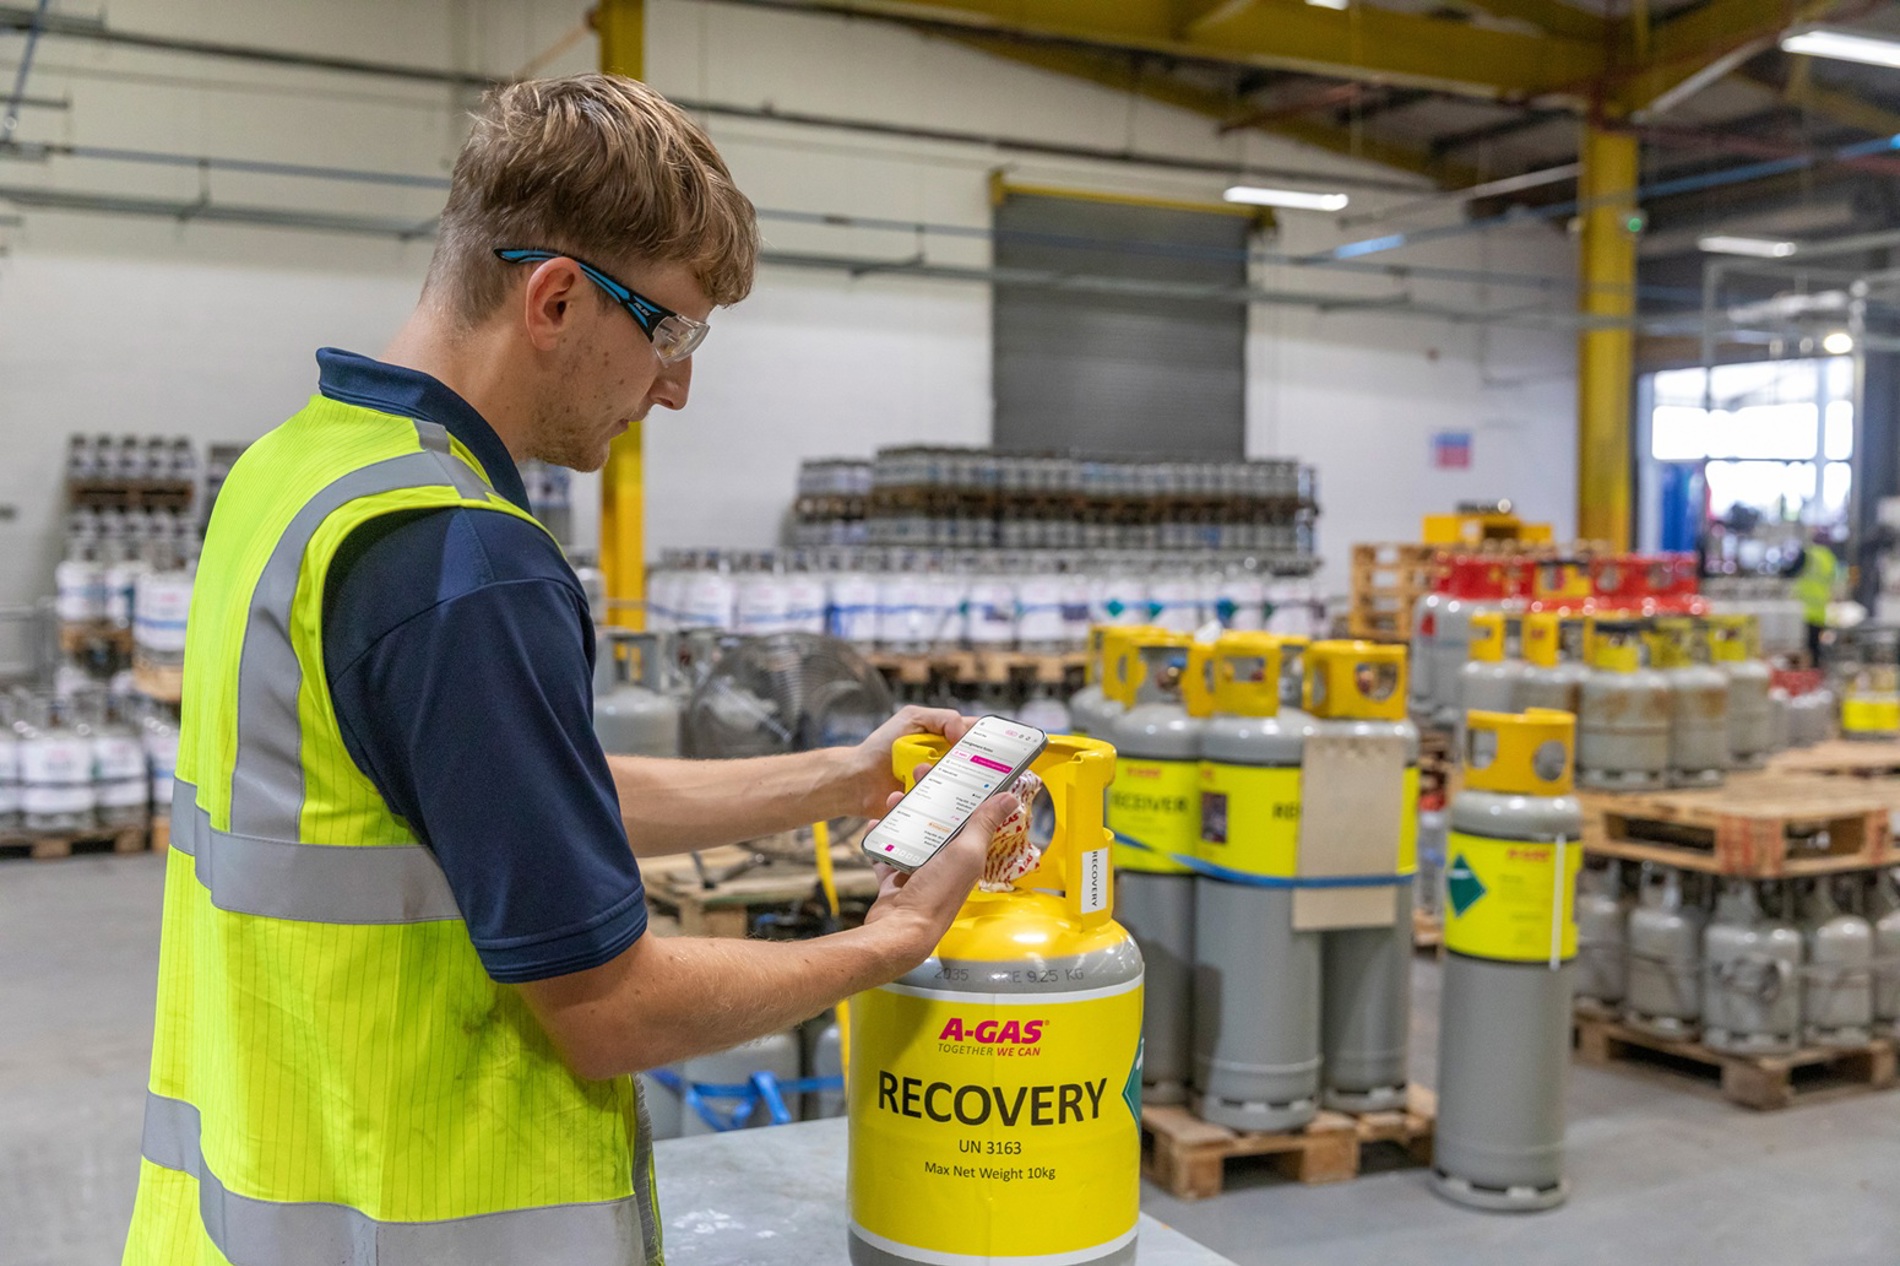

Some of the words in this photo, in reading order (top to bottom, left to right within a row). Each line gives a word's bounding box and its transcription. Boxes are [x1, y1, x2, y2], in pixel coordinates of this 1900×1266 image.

[934, 967, 969, 982] 2035
[1027, 970, 1059, 984] 9.25
[1064, 968, 1085, 981] KG
[938, 1043, 993, 1056] TOGETHER
[997, 1047, 1015, 1057] WE
[1017, 1047, 1041, 1057] CAN
[878, 1070, 1108, 1127] RECOVERY
[959, 1139, 981, 1154] UN
[986, 1141, 1022, 1155] 3163
[924, 1161, 950, 1176] Max
[953, 1165, 976, 1178] Net
[979, 1167, 1023, 1182] Weight
[1027, 1167, 1056, 1180] 10kg
